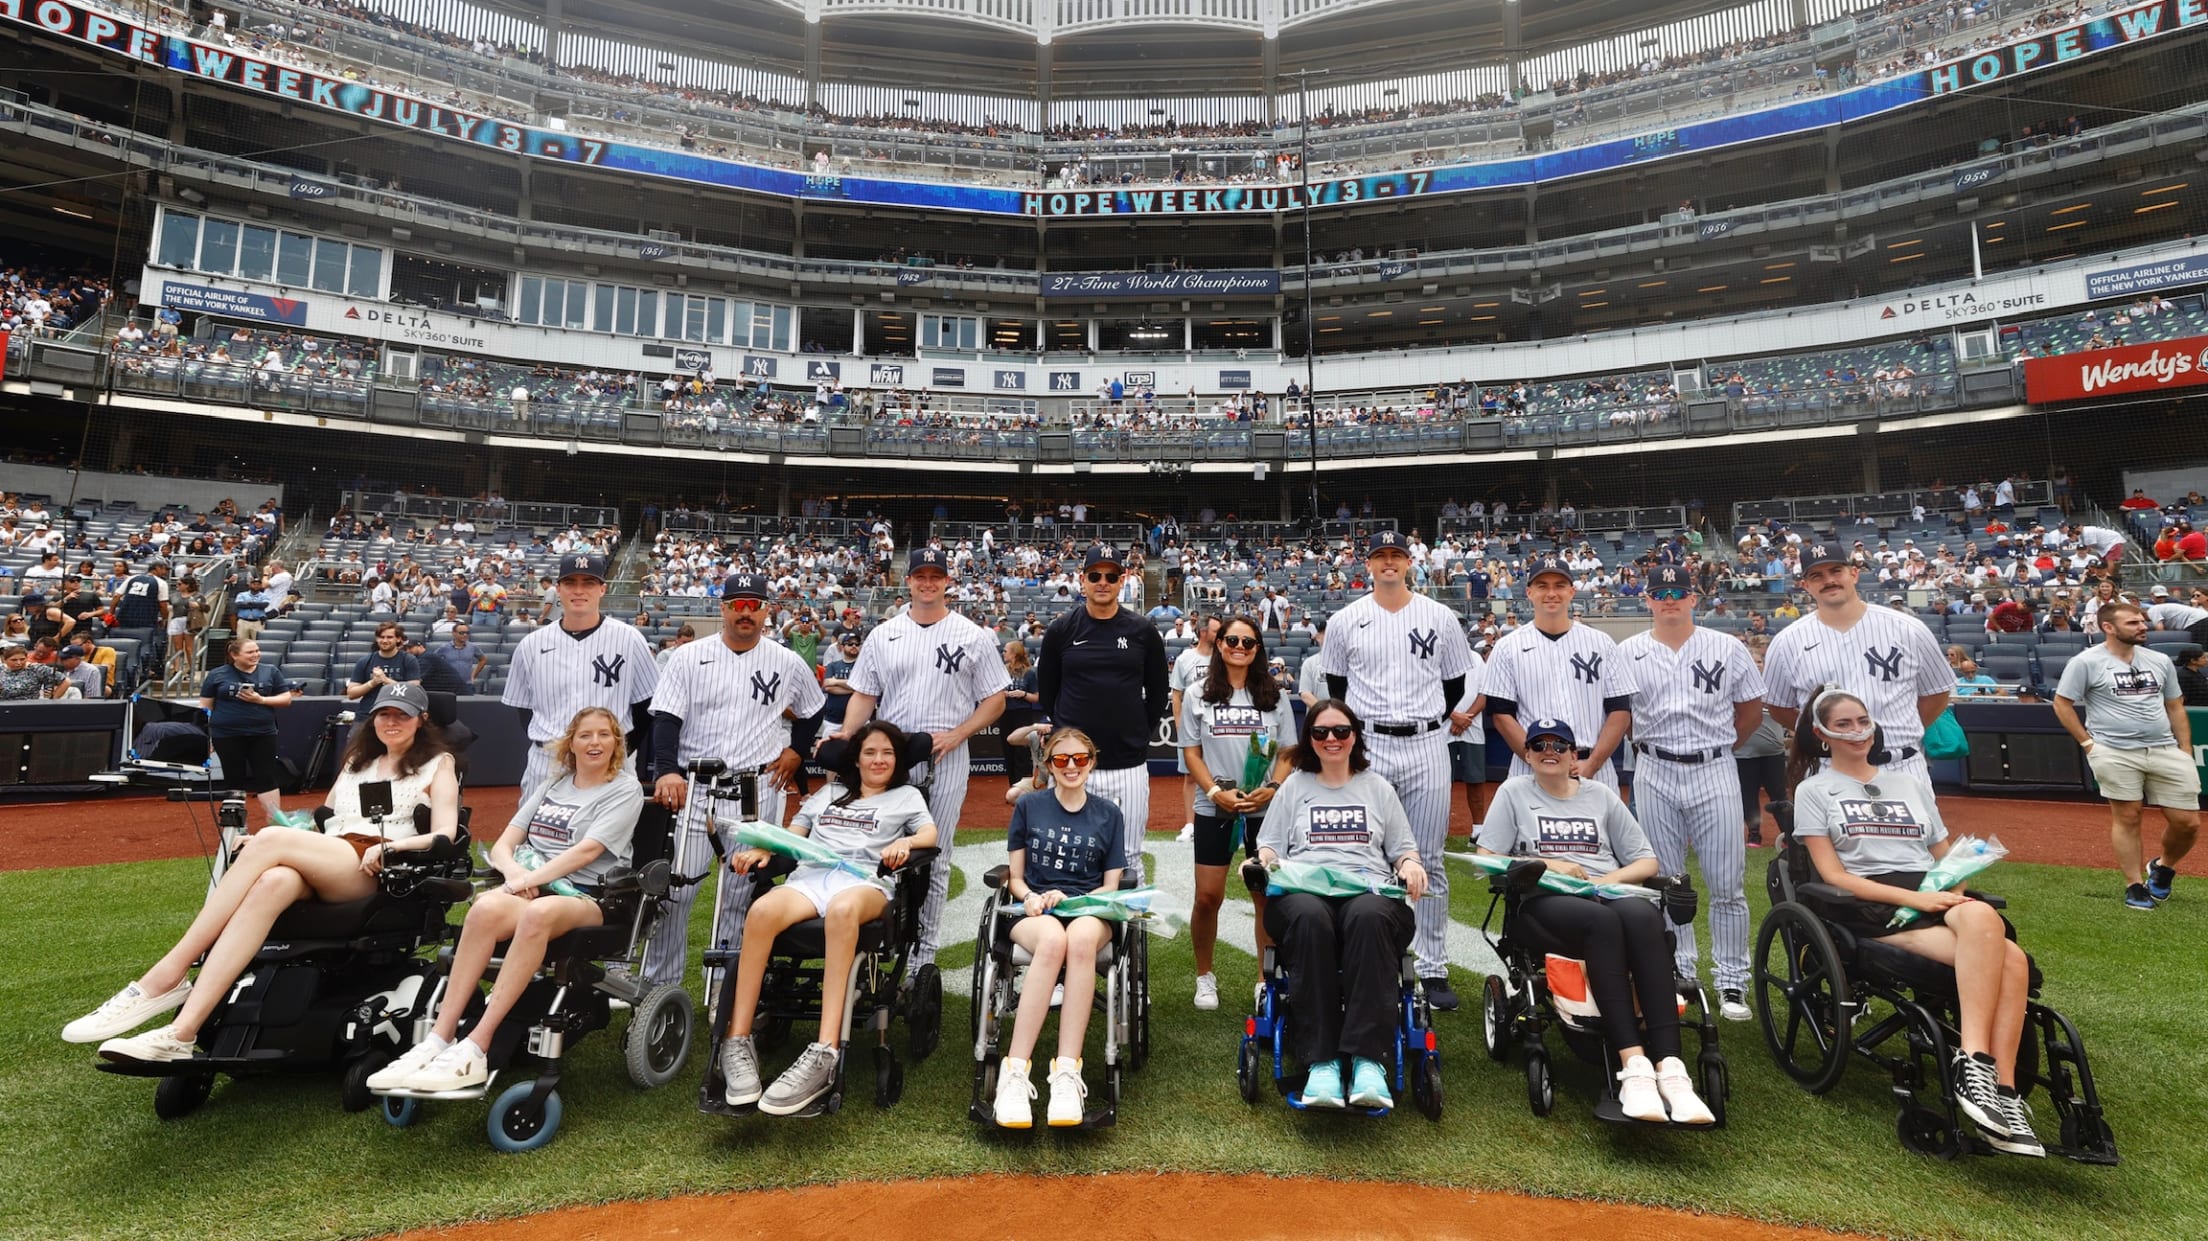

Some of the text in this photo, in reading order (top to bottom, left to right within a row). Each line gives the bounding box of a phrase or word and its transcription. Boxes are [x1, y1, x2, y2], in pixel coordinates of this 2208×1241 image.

[1931, 28, 2083, 95] HOPE
[194, 46, 340, 108] WEEK
[365, 93, 478, 140] JULY
[501, 126, 521, 151] 3
[584, 142, 602, 165] 7
[1956, 169, 1989, 186] 1958
[292, 183, 324, 196] 1950
[1025, 192, 1113, 216] HOPE
[1131, 190, 1224, 213] WEEK
[1240, 184, 1323, 210] JULY
[1343, 181, 1358, 201] 3
[1411, 173, 1428, 194] 7
[1702, 222, 1729, 236] 1956
[641, 246, 664, 256] 1951
[2090, 263, 2186, 286] OFFICIAL AIRLINE OF
[1050, 273, 1271, 295] 27-Time World Champions
[2091, 285, 2110, 295] THE
[2112, 281, 2134, 291] NEW
[2135, 276, 2163, 287] YORK
[165, 286, 202, 298] OFFICIAL
[204, 292, 236, 304] AIRLINE
[165, 295, 181, 303] THE
[183, 298, 204, 307] NEW
[204, 300, 228, 310] YORK
[1904, 292, 1976, 314] DELTA
[2002, 294, 2045, 309] SUITE
[368, 309, 431, 330] DELTA
[452, 335, 485, 348] SUITE
[872, 367, 901, 384] WFAN
[2081, 349, 2192, 392] Wendy's
[128, 581, 150, 597] 21
[1215, 708, 1260, 721] HOPE
[537, 803, 577, 820] HOPE
[1312, 809, 1364, 824] HOPE
[1541, 820, 1595, 836] HOPE
[1047, 828, 1096, 847] BASE
[1032, 838, 1080, 858] BALL
[1031, 852, 1078, 872] BEST
